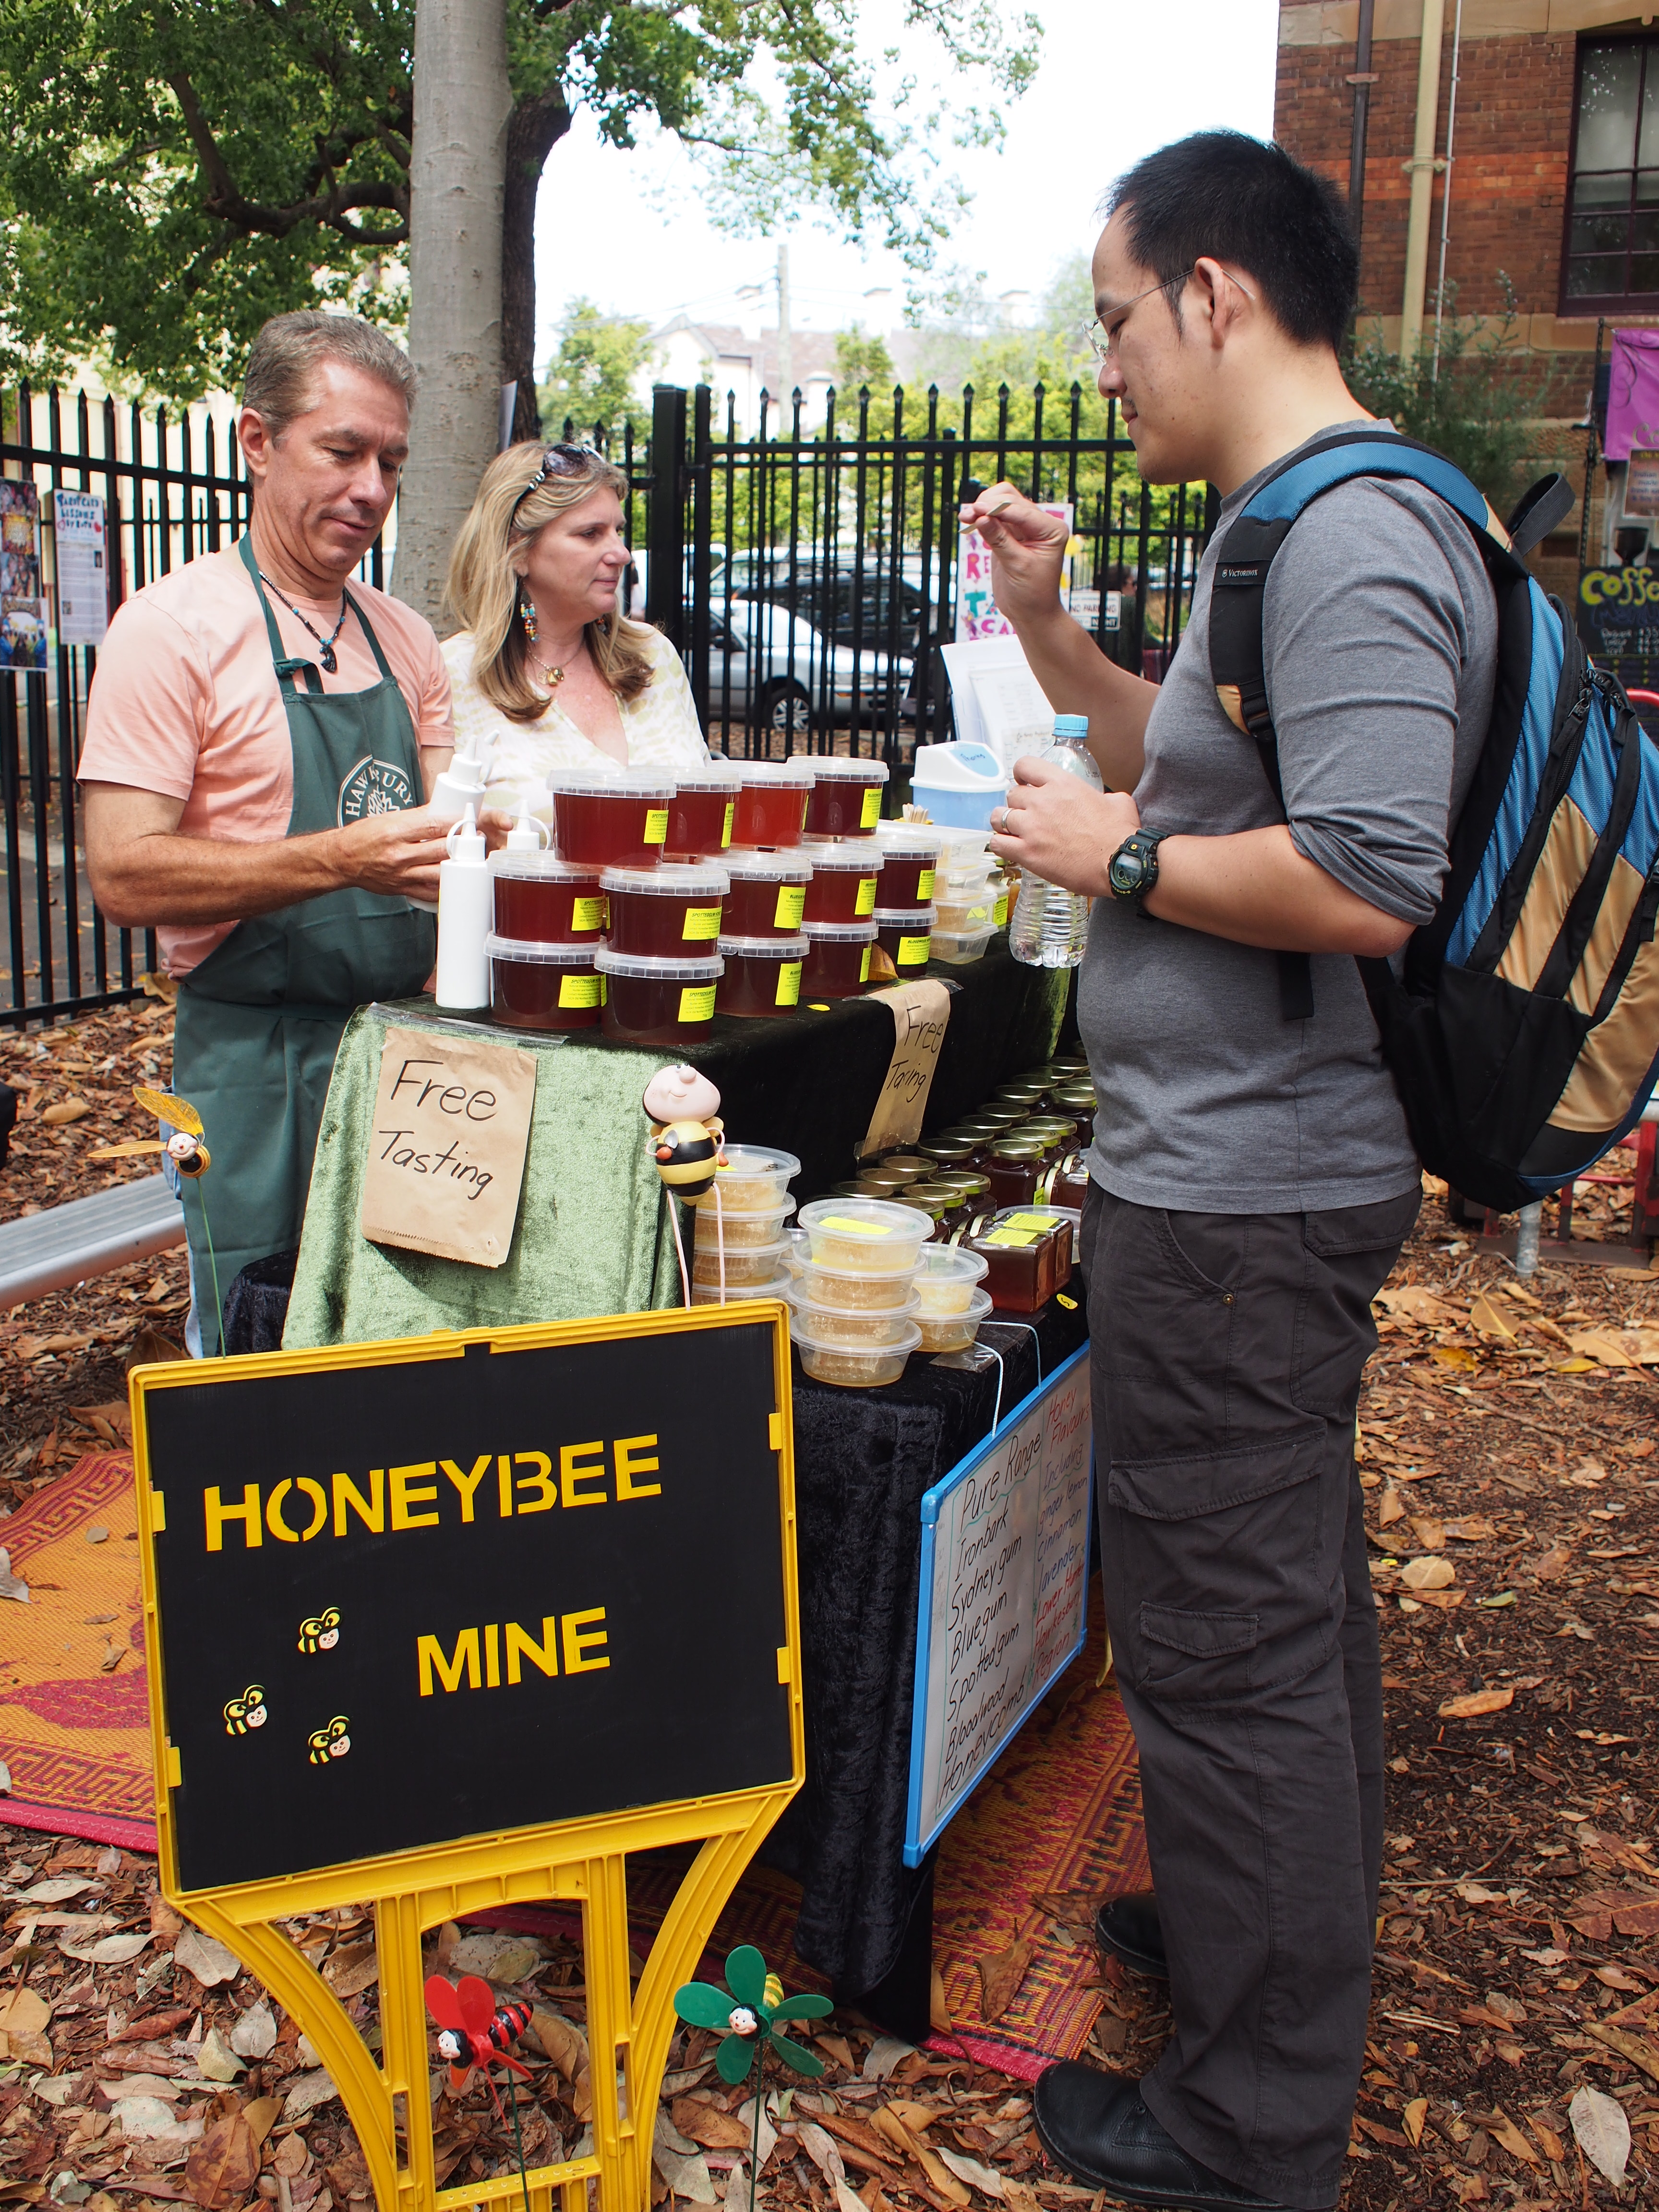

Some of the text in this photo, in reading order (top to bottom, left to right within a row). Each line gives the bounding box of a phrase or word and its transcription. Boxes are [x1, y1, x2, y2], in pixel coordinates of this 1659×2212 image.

[904, 1005, 944, 1054] Free
[390, 1059, 498, 1122] Free
[379, 1130, 493, 1201] Tasting
[1046, 1387, 1077, 1433] Honey
[1050, 1403, 1090, 1454] Flavours
[204, 1433, 662, 1552] HONEYBEE
[961, 1433, 1042, 1534] Pure Range
[1043, 1443, 1084, 1491] Including
[955, 1495, 1009, 1582] Ironbark
[1038, 1479, 1087, 1537] ginger lemon
[1038, 1538, 1081, 1599] lavender
[1033, 1587, 1082, 1660] Hawkesbury
[1035, 1586, 1063, 1629] Lower
[417, 1606, 611, 1696] MINE
[1032, 1630, 1070, 1690] Region
[938, 1665, 1027, 1809] Honeycomb
[946, 1666, 1010, 1764] Bloodwood
